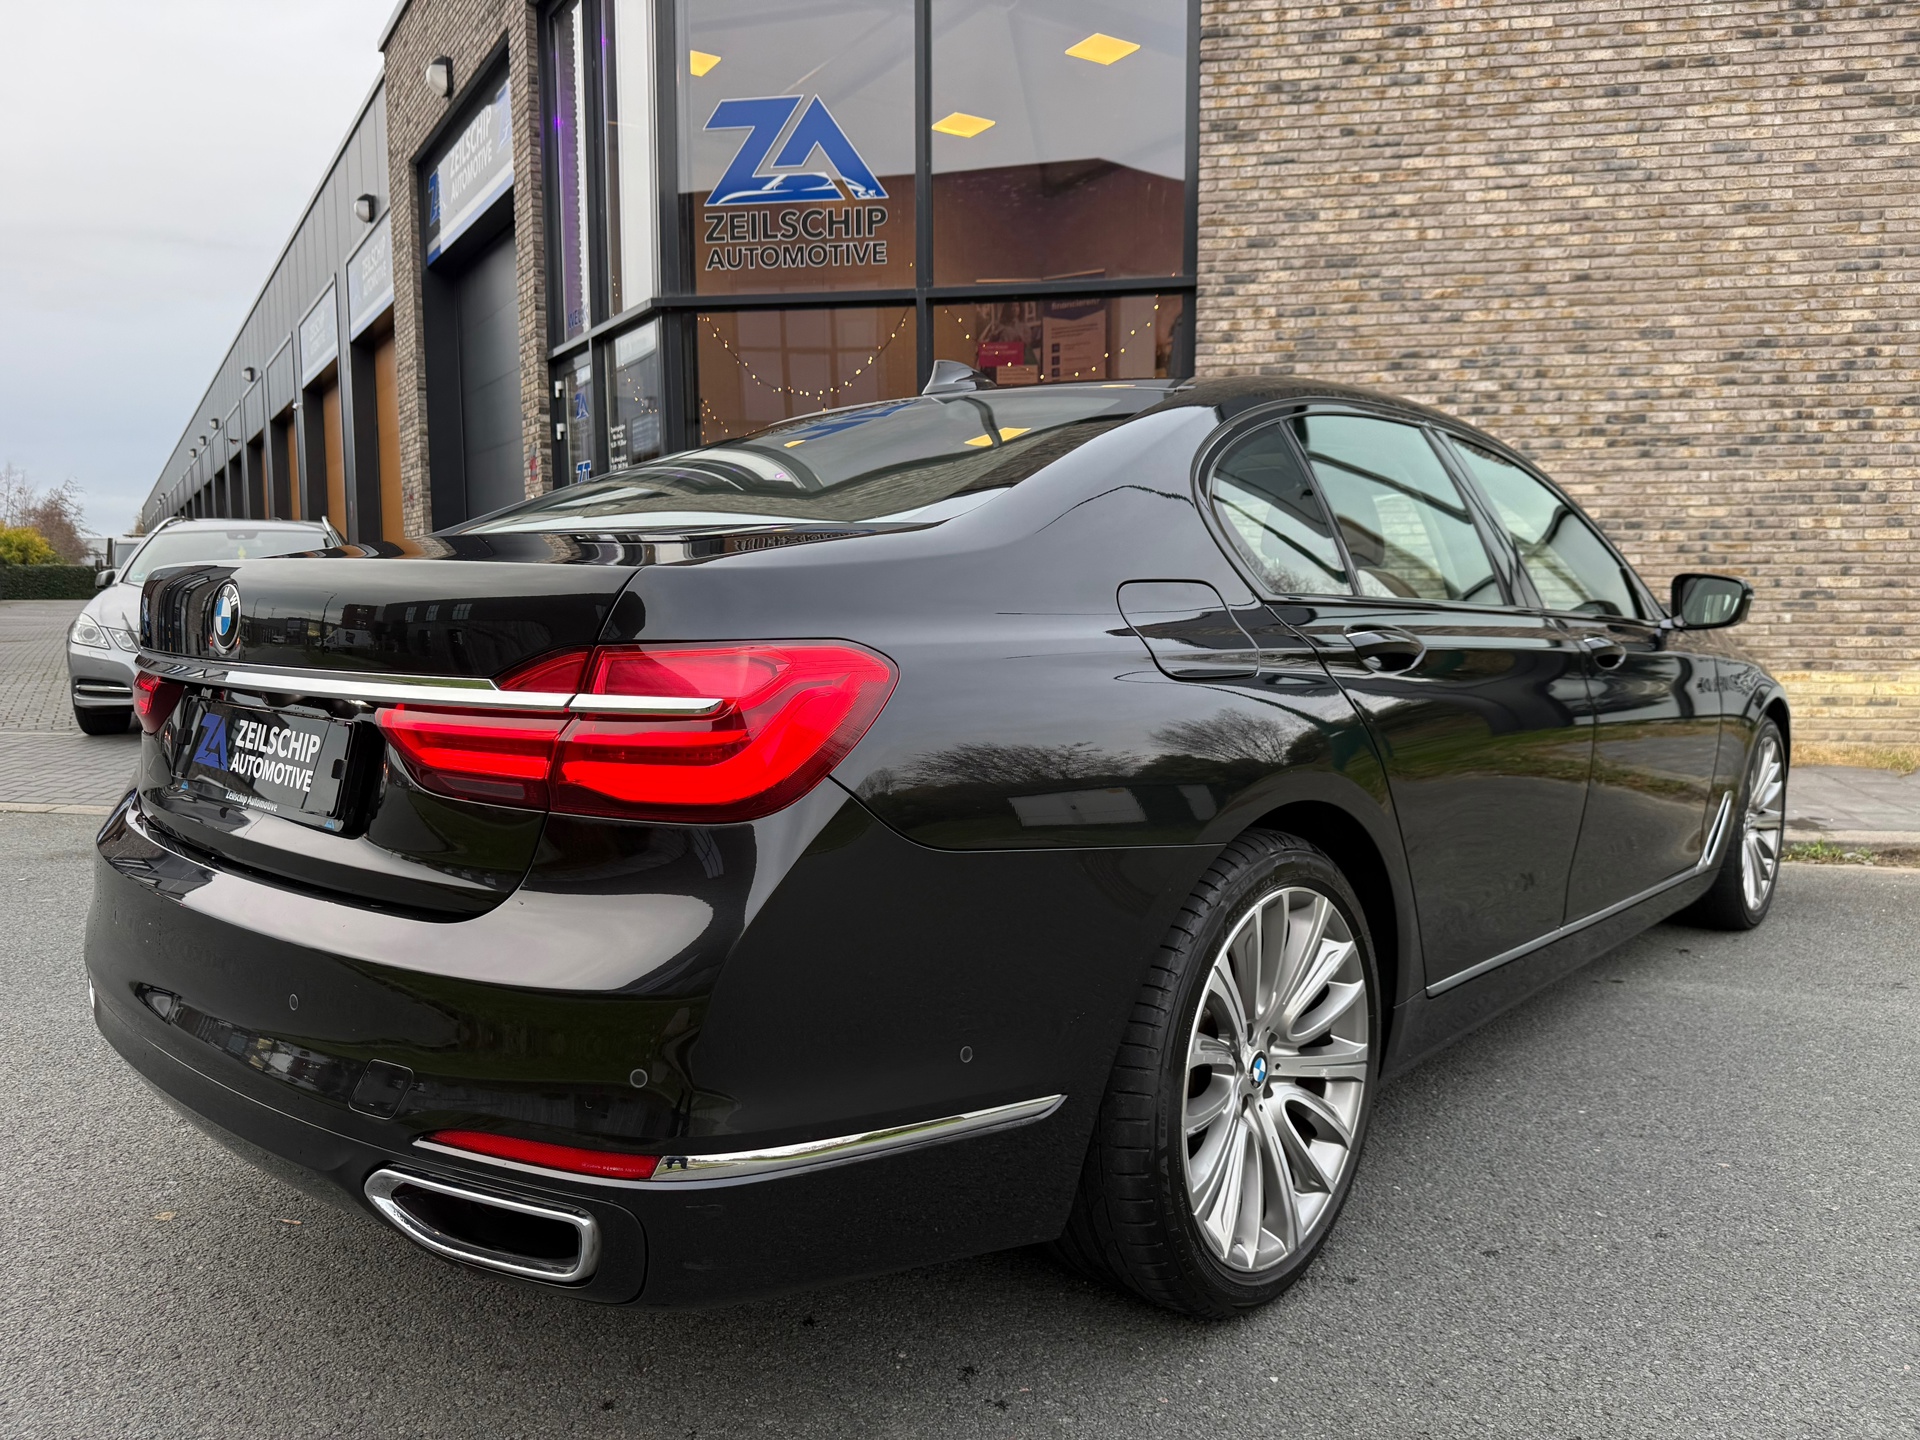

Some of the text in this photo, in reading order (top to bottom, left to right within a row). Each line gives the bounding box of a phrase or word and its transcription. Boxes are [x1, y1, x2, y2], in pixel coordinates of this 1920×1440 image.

[449, 104, 492, 178] ZEILSCHIP
[450, 140, 493, 203] AUTOMOTIVE
[705, 207, 887, 243] ZEILSCHIP
[705, 241, 887, 271] AUTOMOTIVE
[235, 719, 321, 763] ZEILSCHIP
[230, 752, 313, 792] AUTOMOTIVE
[225, 789, 278, 812] Zeilschip Automotive
